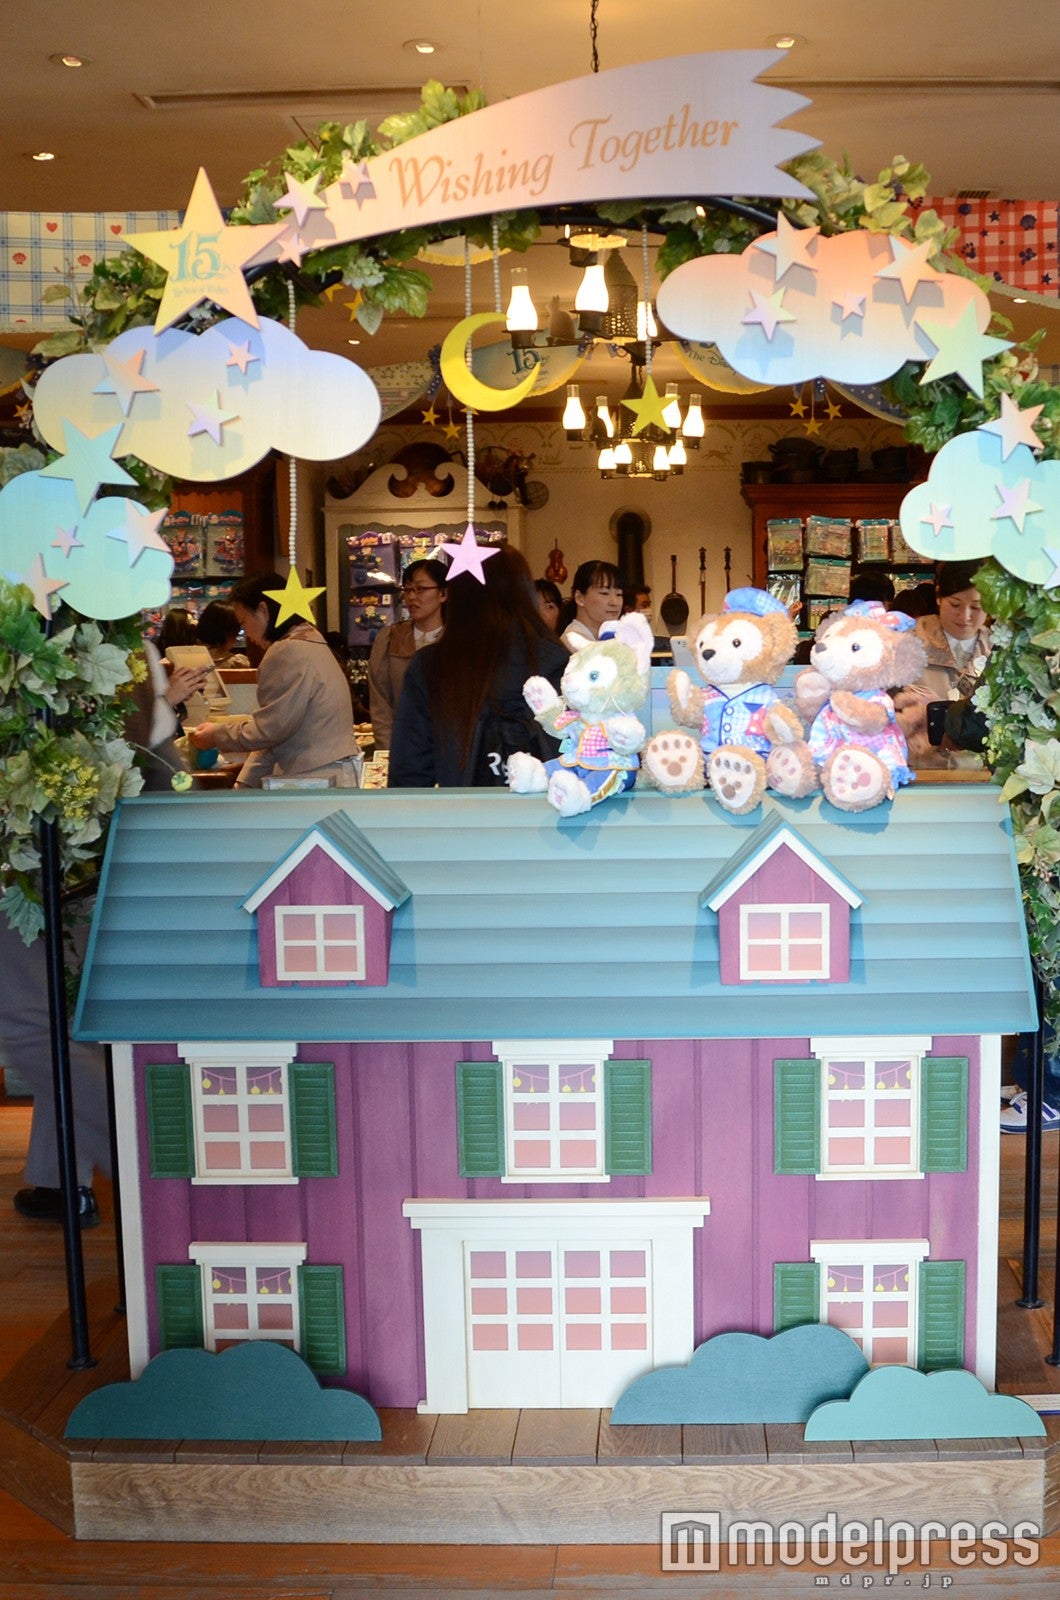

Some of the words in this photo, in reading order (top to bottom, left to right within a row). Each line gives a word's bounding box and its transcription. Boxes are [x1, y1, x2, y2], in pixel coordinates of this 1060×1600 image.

[389, 149, 554, 209] Wishing
[568, 103, 740, 173] Together
[169, 229, 224, 283] 15
